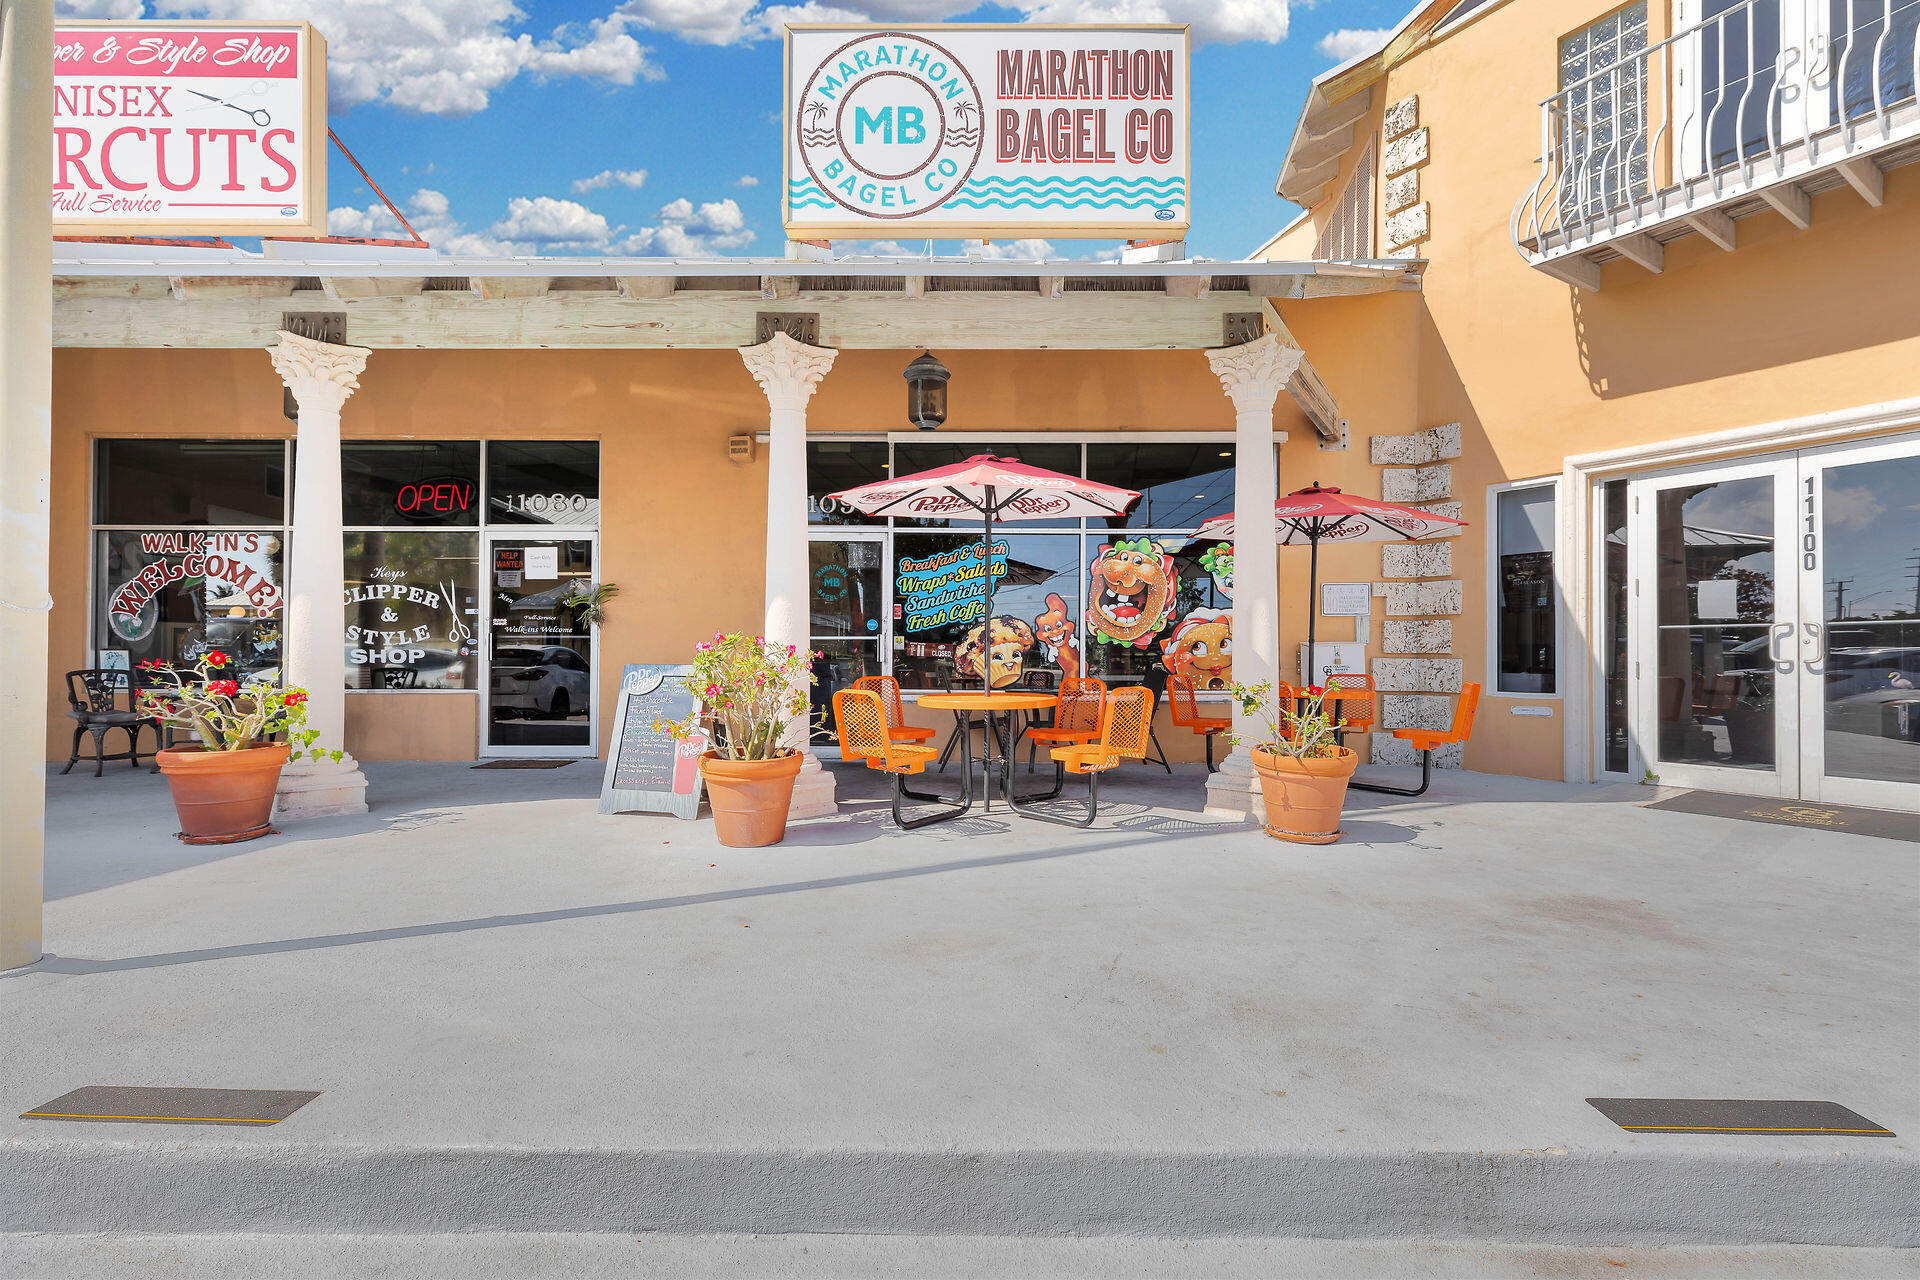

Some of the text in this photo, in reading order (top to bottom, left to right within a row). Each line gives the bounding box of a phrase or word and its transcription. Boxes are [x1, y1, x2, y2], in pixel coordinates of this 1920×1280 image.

[93, 36, 122, 63] &
[126, 36, 207, 74] Style
[212, 37, 291, 72] Shop
[818, 44, 966, 101] MARATHON
[997, 49, 1173, 100] MARATHON
[855, 105, 927, 145] MB
[997, 108, 1174, 164] BAGEL CO
[823, 158, 959, 208] BAGEL CO
[53, 191, 162, 213] Full Service
[397, 484, 470, 511] OPEN
[506, 493, 588, 513] 11080
[1007, 499, 1062, 514] Pepper
[1020, 497, 1043, 507] Dr
[1804, 476, 1816, 571] 11100
[496, 560, 524, 568] WANTED
[501, 552, 518, 560] HELP
[901, 551, 959, 572] Breakfast
[960, 547, 972, 560] &
[370, 565, 408, 582] Keys
[816, 564, 848, 577] MARATHON
[110, 554, 284, 619] WELCOME!
[823, 577, 840, 587] MB
[898, 575, 948, 593] Wraps
[498, 592, 514, 604] Men
[817, 589, 838, 600] BAGEL
[906, 586, 986, 611] Sandwiche
[380, 607, 398, 622] &
[908, 610, 946, 630] Fresh
[949, 601, 986, 621] Coffe
[346, 625, 431, 646] STYLE
[504, 626, 539, 634] Walk-ins
[350, 648, 426, 664] SHOP
[624, 671, 660, 691] Pepper
[640, 669, 652, 679] Dr
